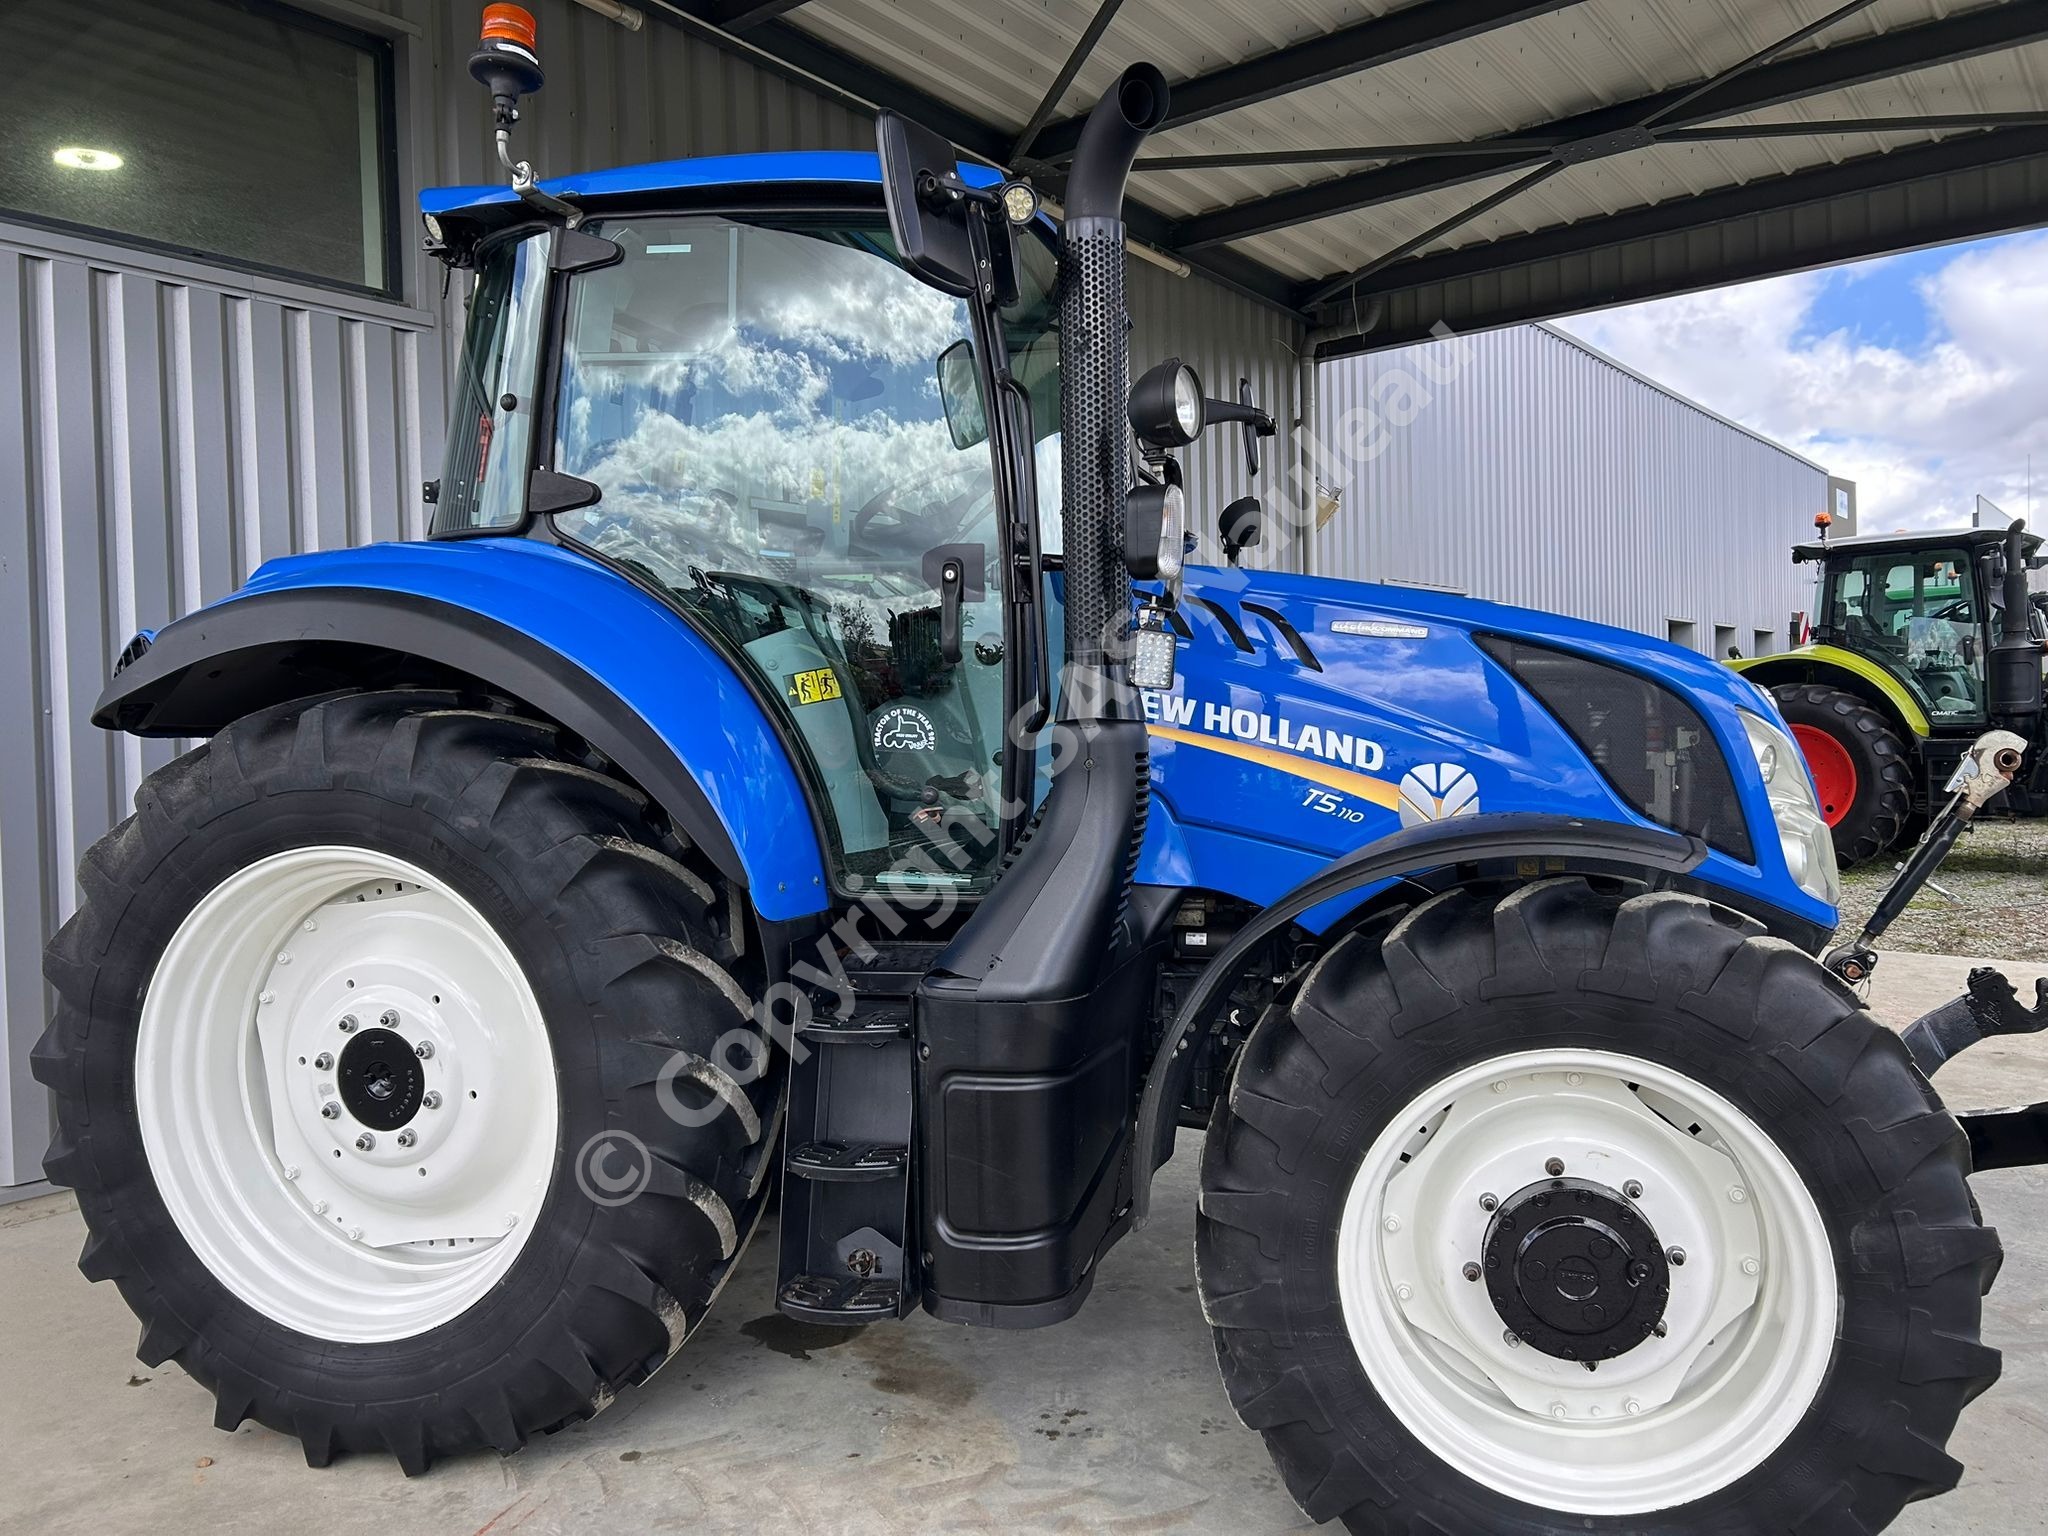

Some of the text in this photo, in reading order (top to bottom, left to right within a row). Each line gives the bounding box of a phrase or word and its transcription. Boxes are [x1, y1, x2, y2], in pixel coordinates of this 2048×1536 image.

[874, 713, 891, 747] TRACTOR
[890, 708, 901, 717] OF
[902, 708, 917, 717] THE
[917, 712, 933, 731] YEAR
[927, 731, 935, 751] 2017
[1140, 690, 1385, 772] EW HOLLAND
[1301, 787, 1366, 824] T5.110
